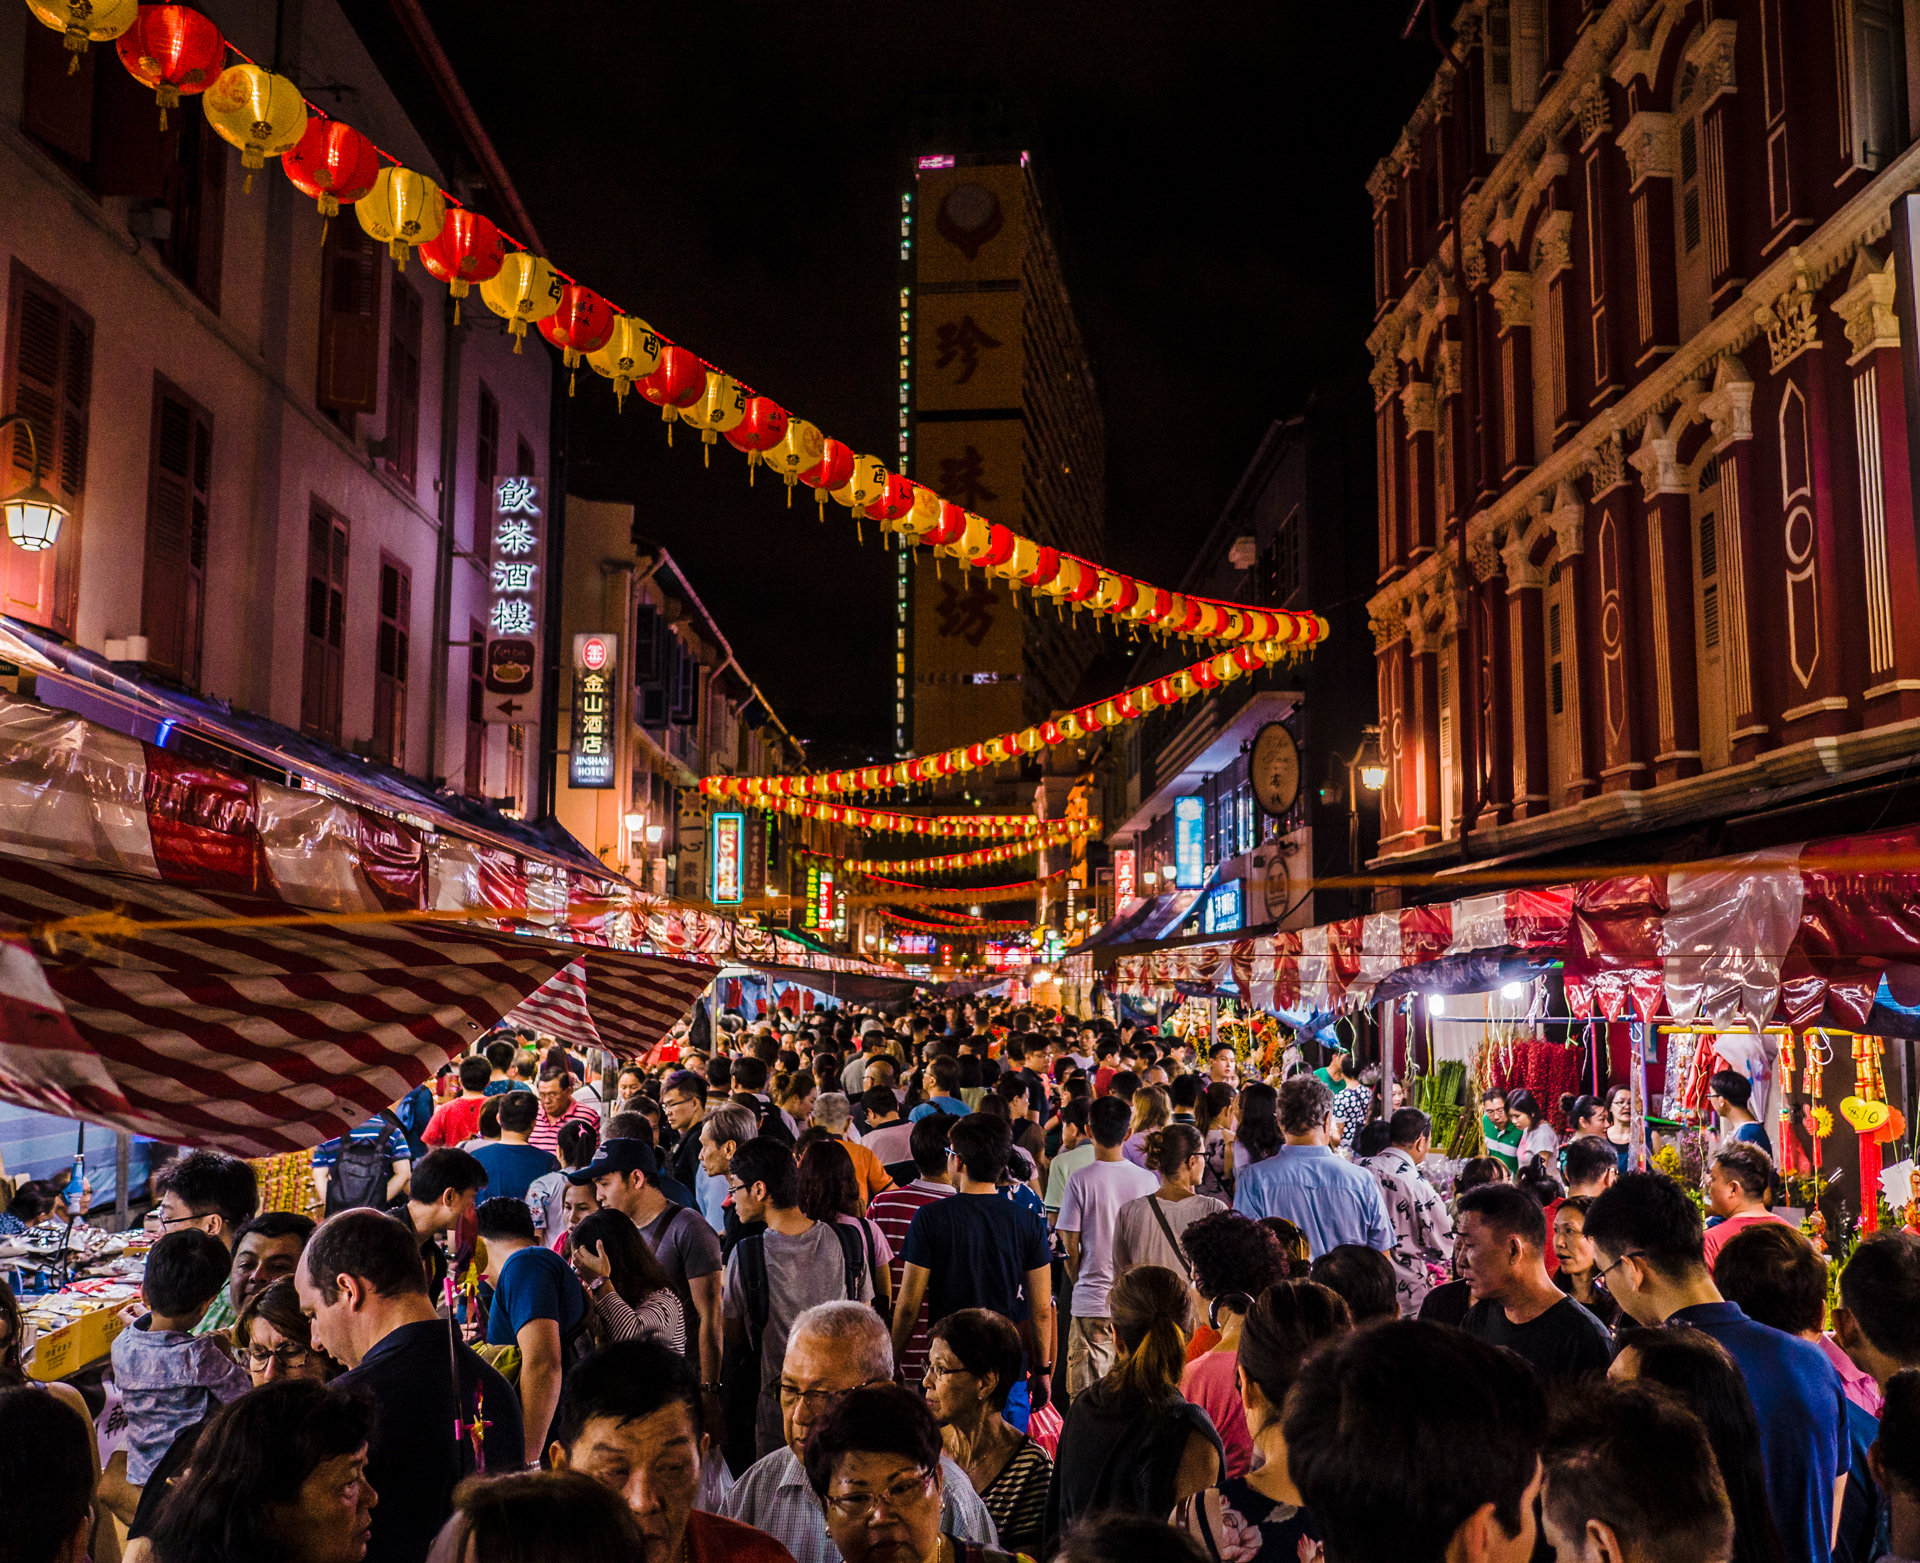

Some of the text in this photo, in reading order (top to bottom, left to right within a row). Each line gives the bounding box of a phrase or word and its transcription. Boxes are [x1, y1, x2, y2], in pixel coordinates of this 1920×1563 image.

[493, 479, 538, 633] 飲茶酒樓
[583, 674, 604, 754] 金山酒店
[575, 756, 609, 766] JINSHAN
[578, 766, 605, 776] HOTEL
